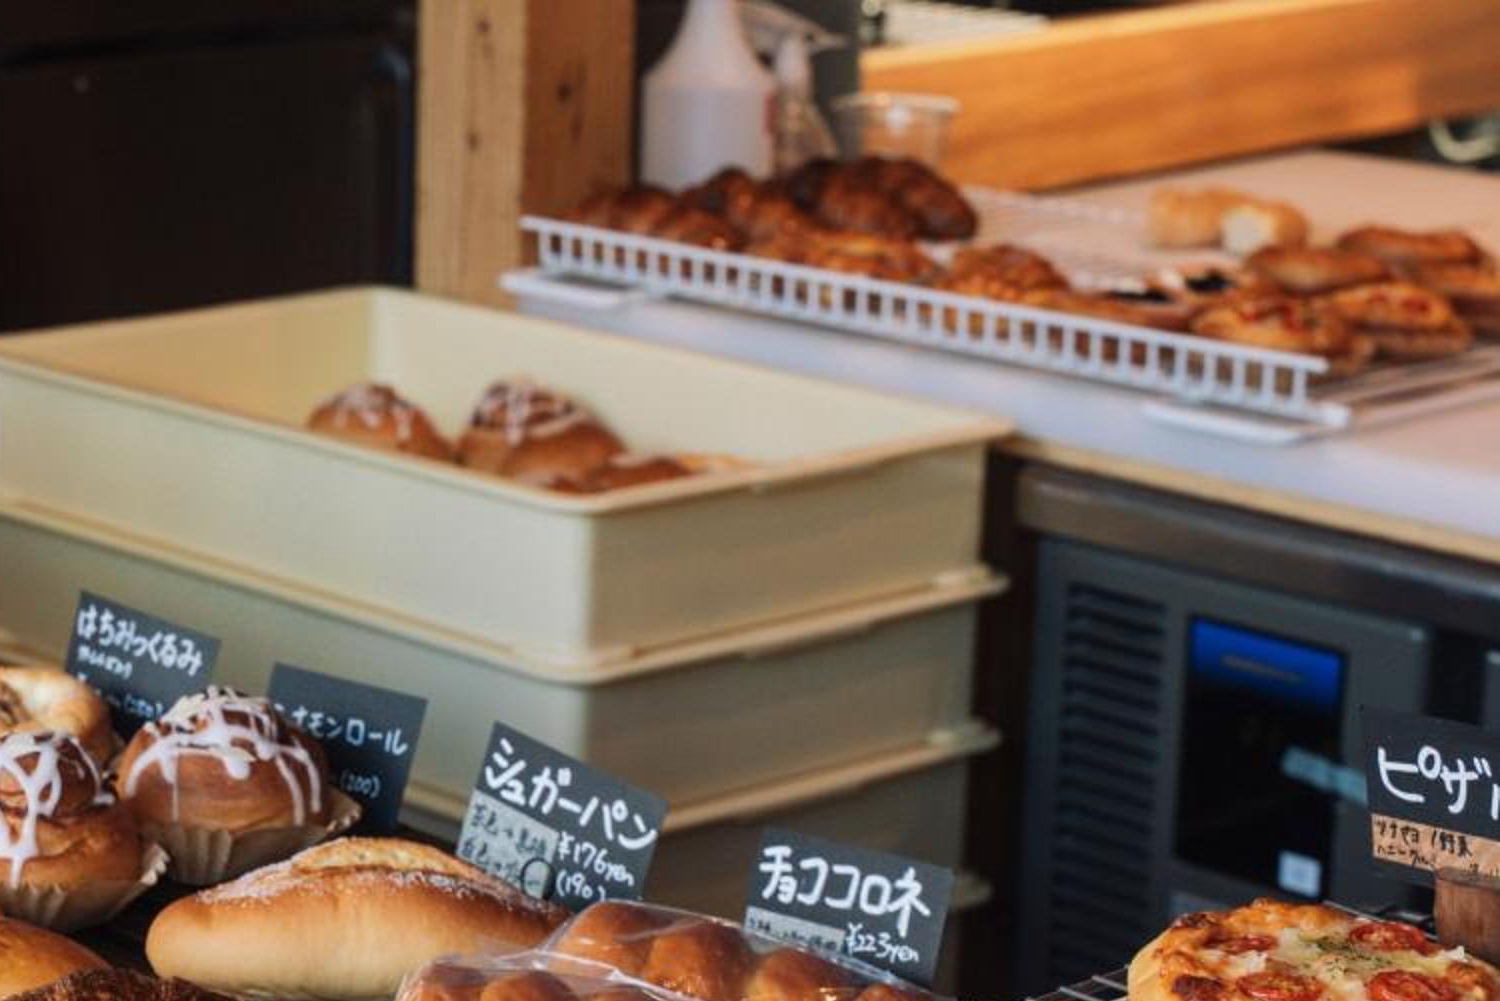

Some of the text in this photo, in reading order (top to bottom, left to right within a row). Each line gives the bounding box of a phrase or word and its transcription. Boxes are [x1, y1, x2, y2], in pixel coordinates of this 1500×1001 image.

[274, 703, 408, 756] ナモンロール
[485, 738, 658, 850] シュガーパン
[555, 869, 606, 902] (190)
[558, 831, 635, 887] ¥176yen
[759, 845, 931, 939] チョココロネ
[845, 922, 920, 964] ¥223yen
